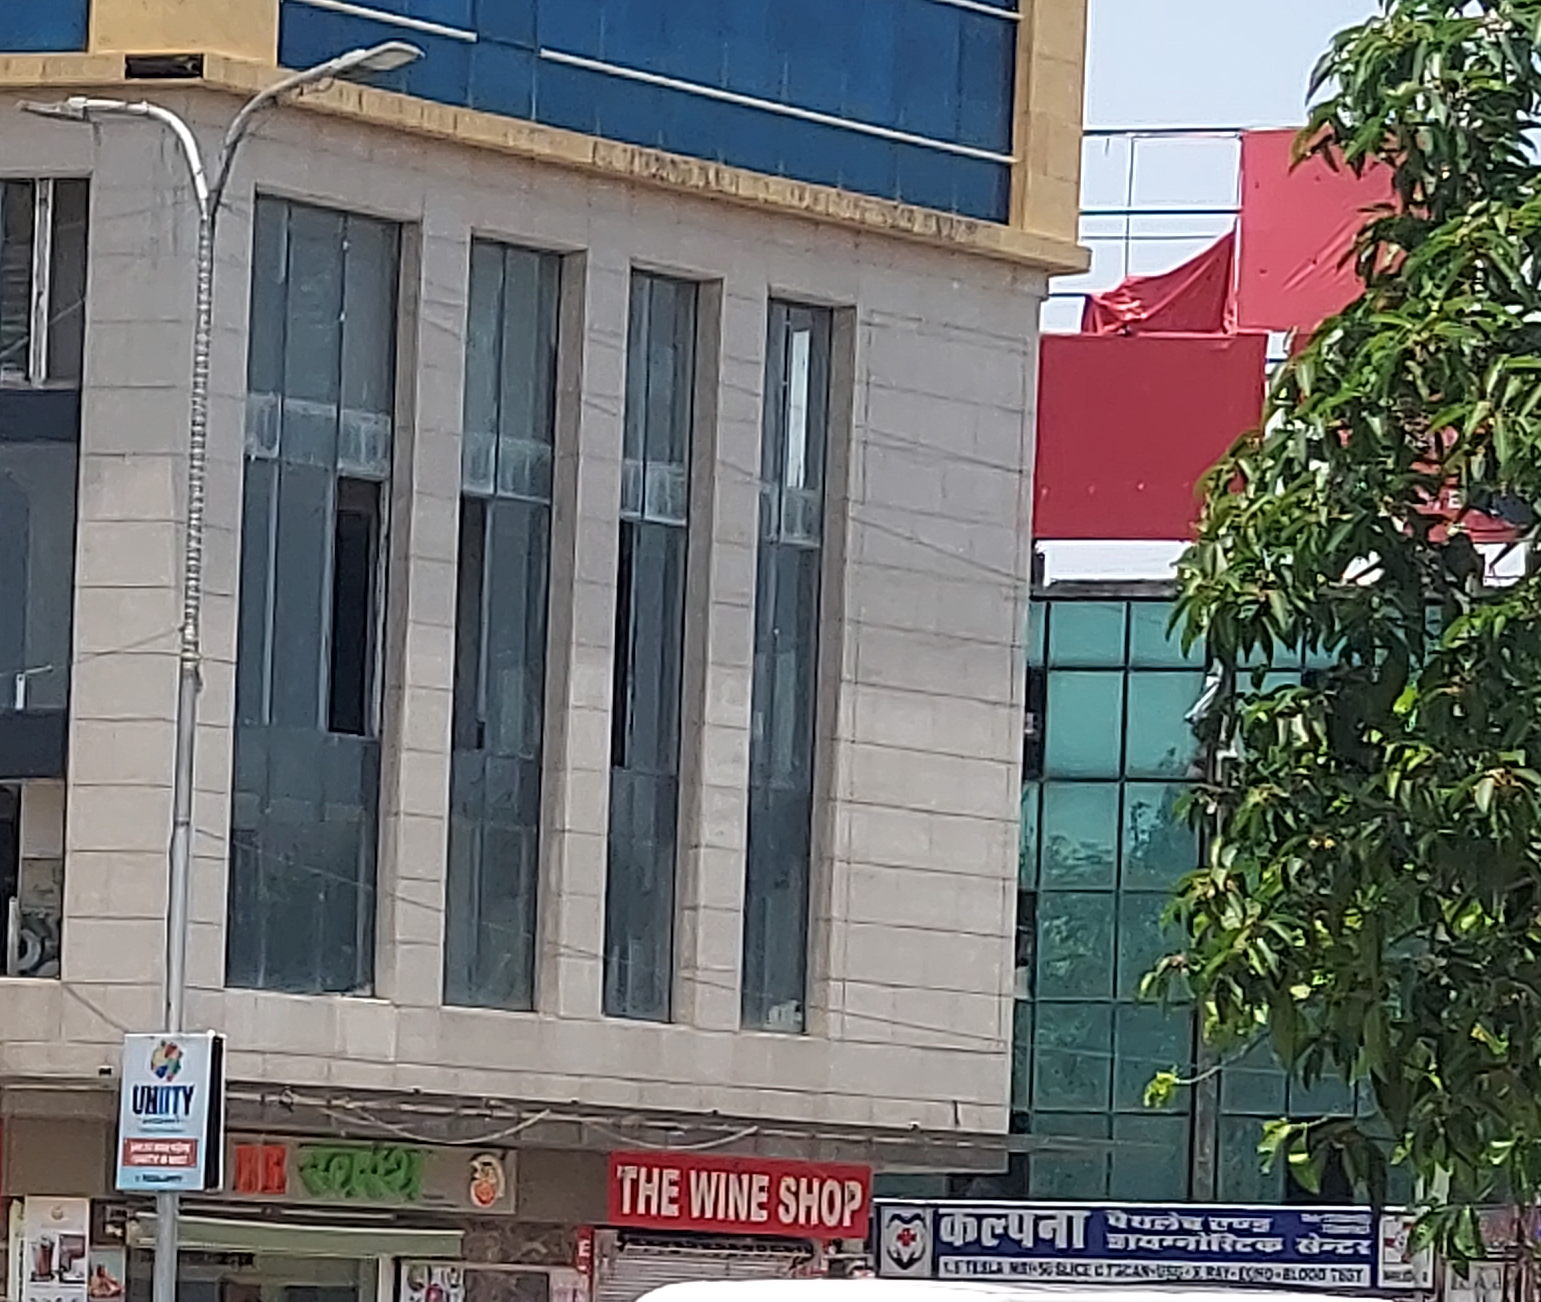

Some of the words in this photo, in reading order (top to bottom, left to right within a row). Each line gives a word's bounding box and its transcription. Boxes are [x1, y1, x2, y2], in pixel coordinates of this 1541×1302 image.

[617, 1164, 680, 1217] THE
[689, 1169, 770, 1223] WINE
[778, 1175, 863, 1228] SHOP
[938, 1207, 1092, 1249] कल्पना
